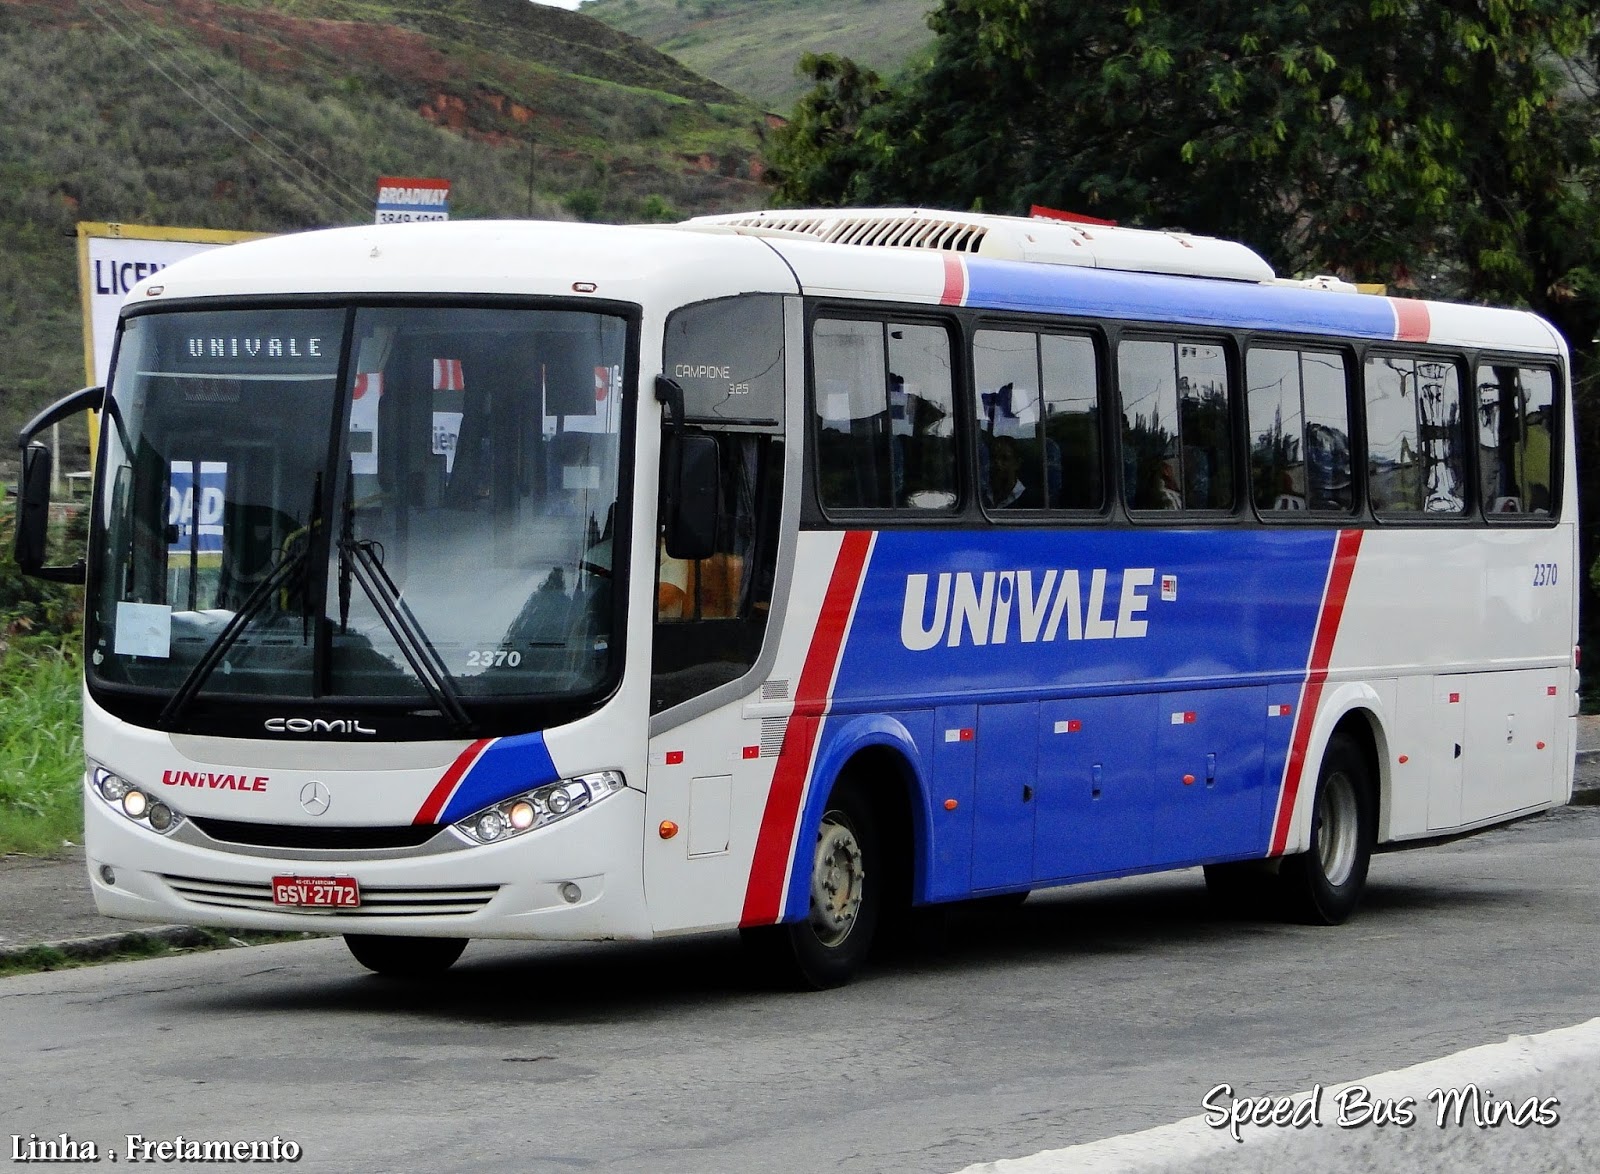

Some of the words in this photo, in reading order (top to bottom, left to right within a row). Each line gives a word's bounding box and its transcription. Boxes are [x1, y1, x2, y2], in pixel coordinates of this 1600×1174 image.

[378, 187, 449, 206] BROADWAY
[189, 338, 322, 357] UNIVALE
[675, 364, 731, 379] CAMPIONE
[728, 383, 750, 395] 325
[1533, 563, 1558, 587] 2370
[900, 567, 1155, 651] UNIVALE
[466, 650, 522, 668] 2370
[264, 717, 377, 735] COMIL
[162, 770, 269, 792] UNIVALE
